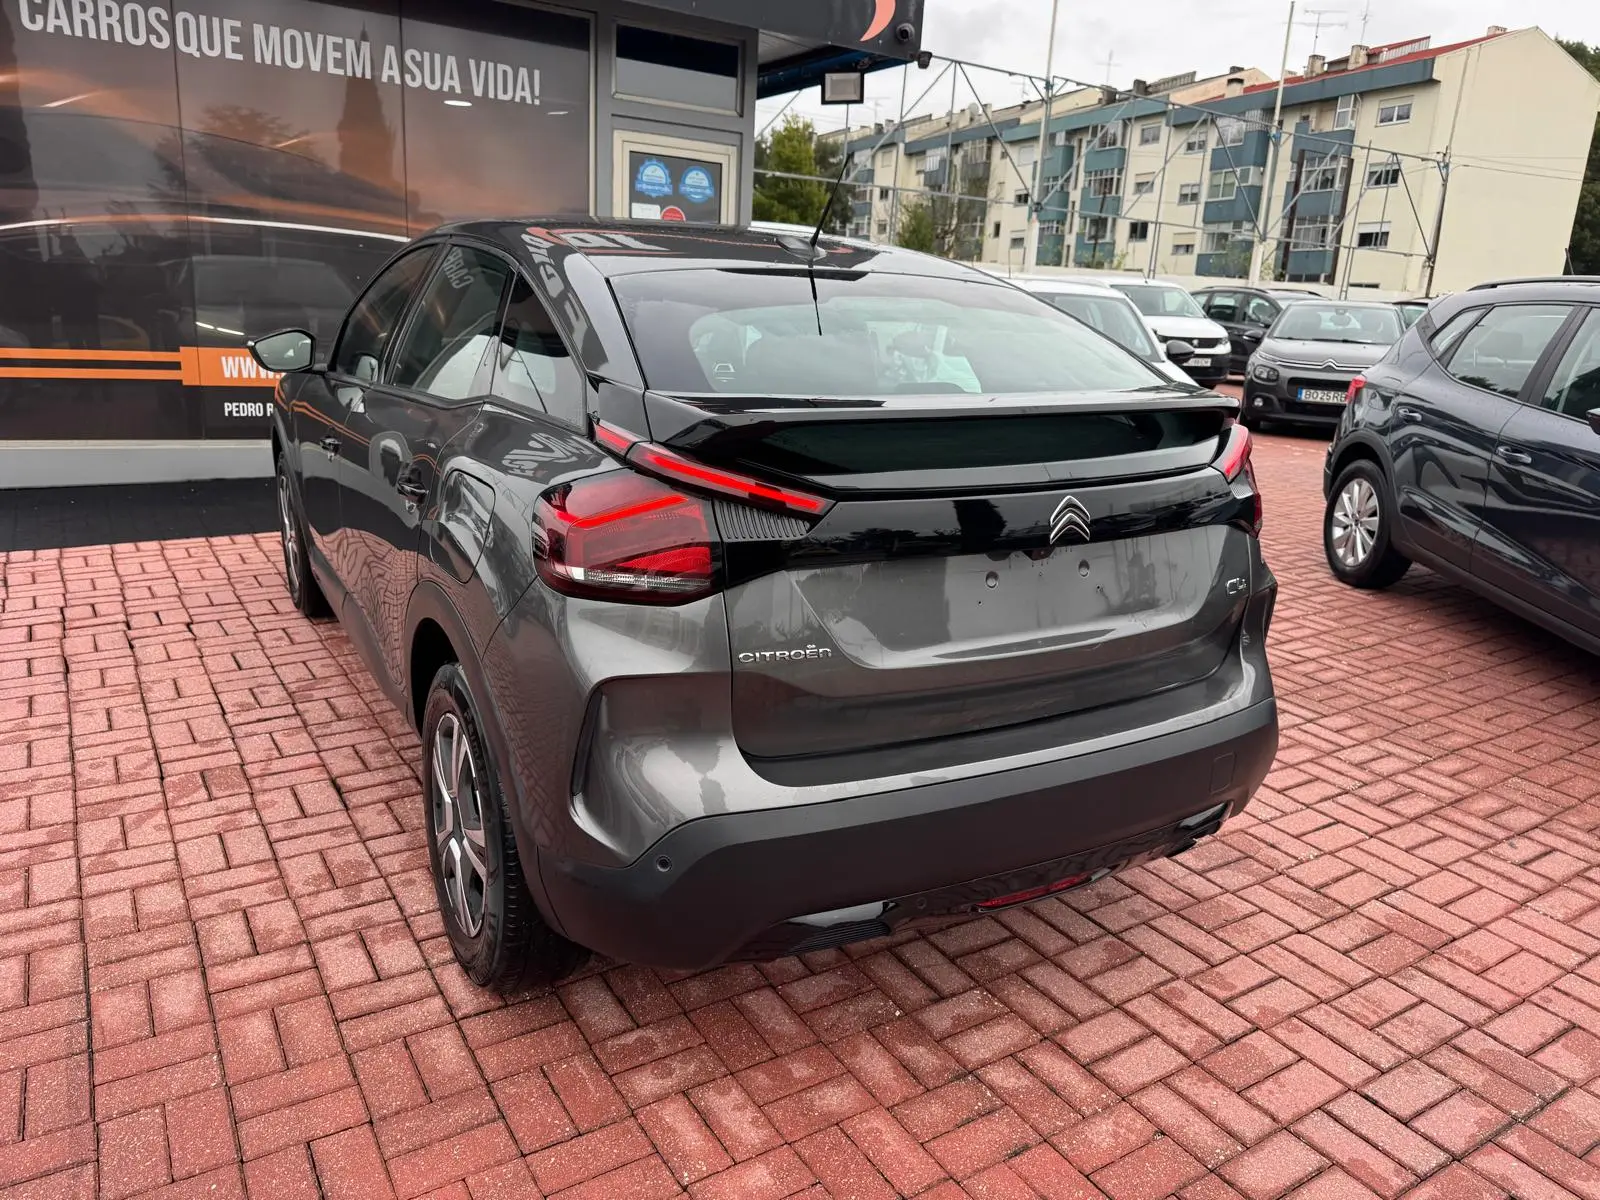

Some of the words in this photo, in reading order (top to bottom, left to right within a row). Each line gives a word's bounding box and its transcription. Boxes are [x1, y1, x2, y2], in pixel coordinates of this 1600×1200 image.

[19, 0, 171, 50] CARROS
[175, 11, 244, 61] QUE
[253, 23, 372, 80] MOVEM
[381, 44, 401, 85] A
[404, 48, 462, 94] SUA
[468, 58, 541, 106] VIDA!
[224, 402, 264, 417] PEDRO
